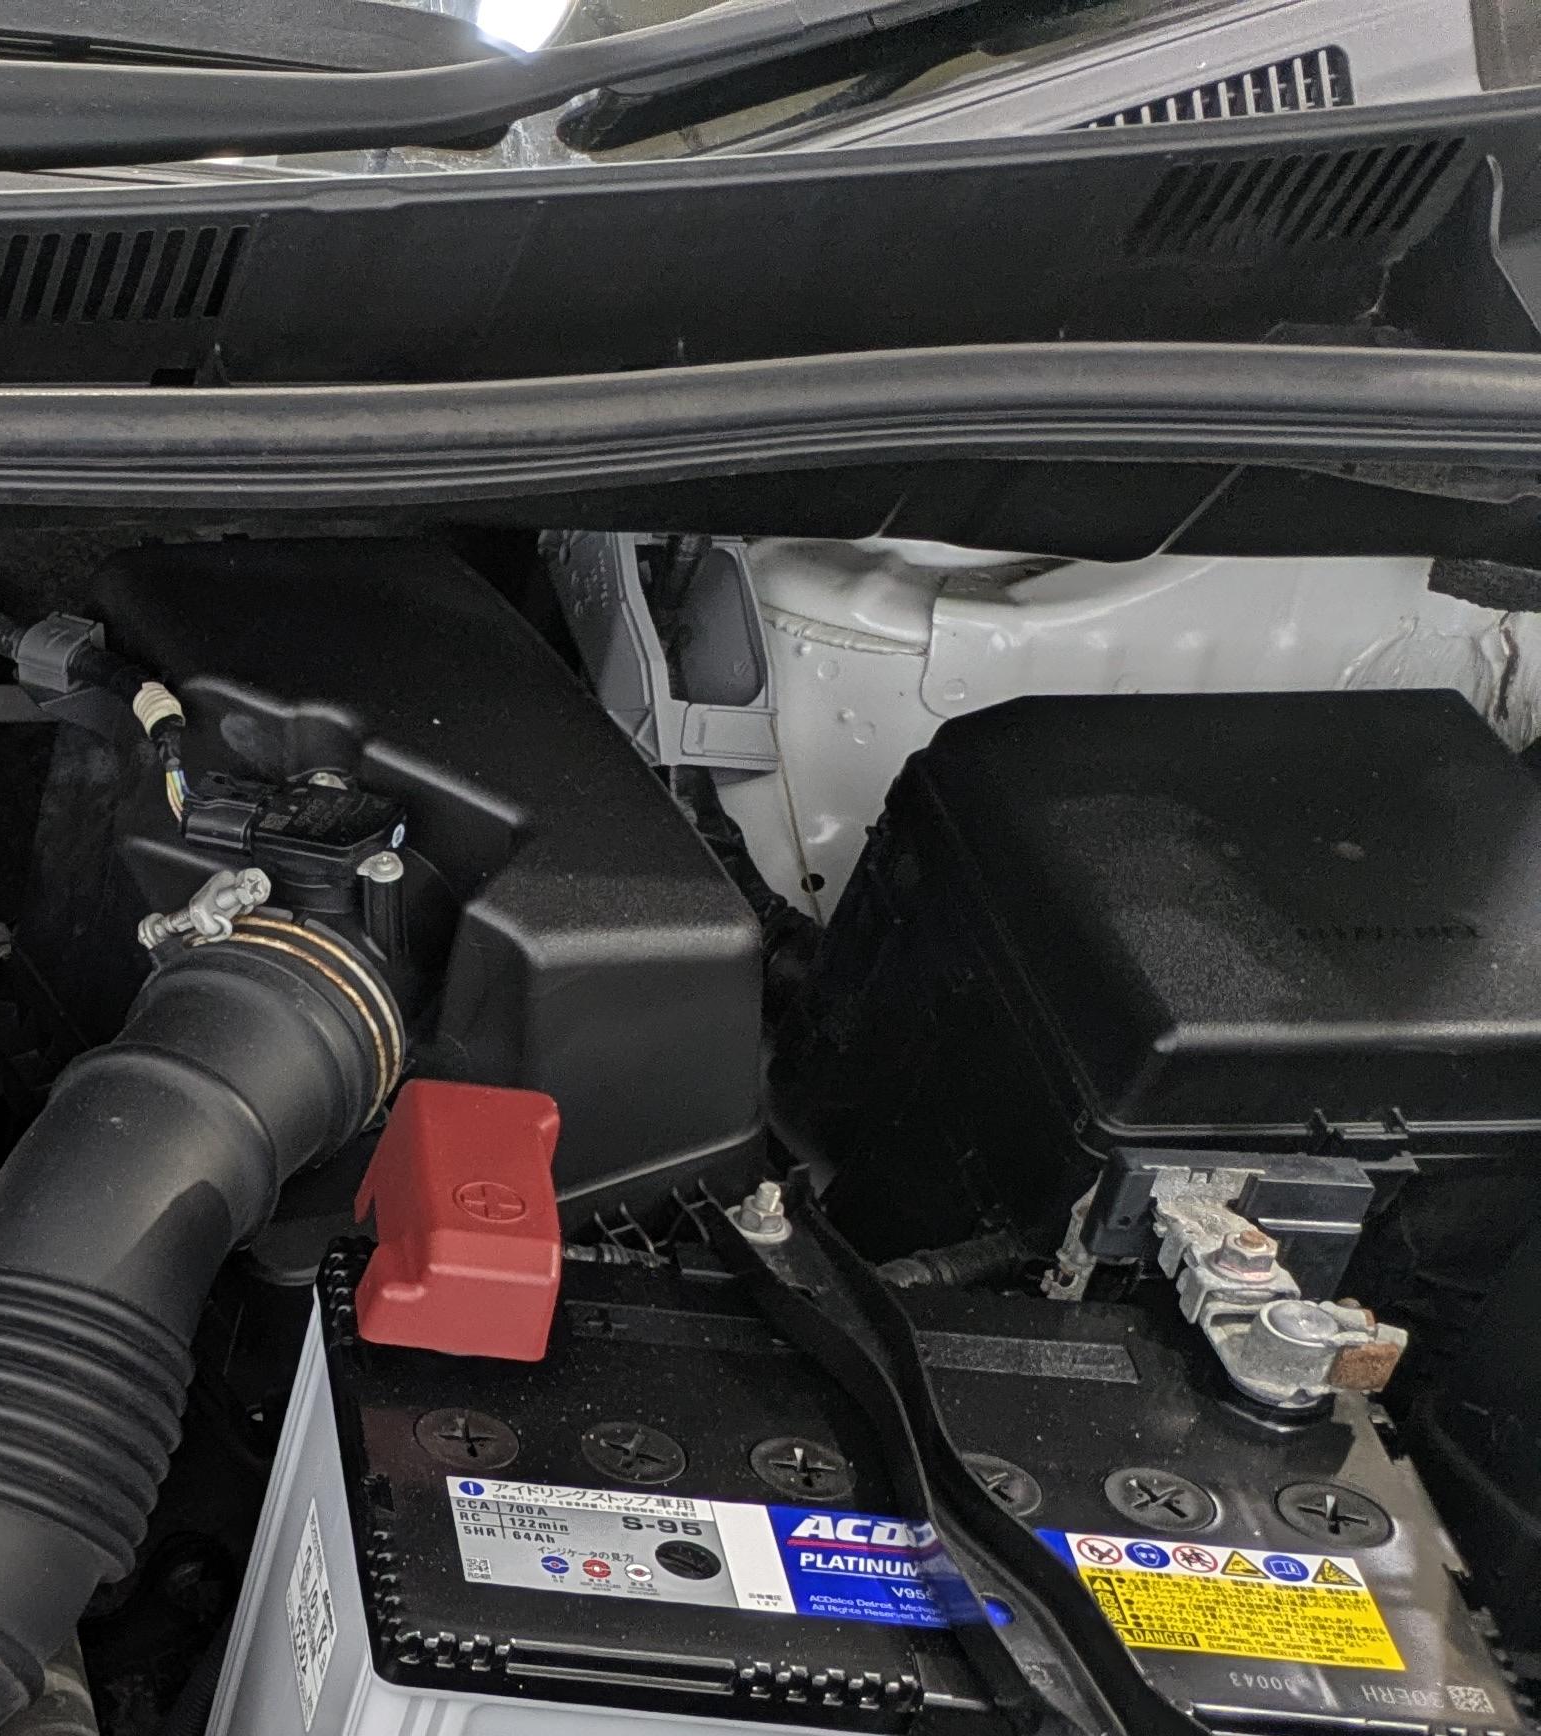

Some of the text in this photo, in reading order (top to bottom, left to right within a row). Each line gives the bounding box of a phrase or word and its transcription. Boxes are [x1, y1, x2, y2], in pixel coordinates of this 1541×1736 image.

[491, 1483, 696, 1512] アイドリングストップ車用
[455, 1500, 490, 1511] CCA
[507, 1503, 549, 1516] 700A
[459, 1511, 569, 1532] RC 122min
[621, 1515, 703, 1537] S-95
[463, 1525, 556, 1544] 5HR 64Ah
[537, 1545, 635, 1563] インジケータの見方
[1129, 1629, 1197, 1646] DANGER
